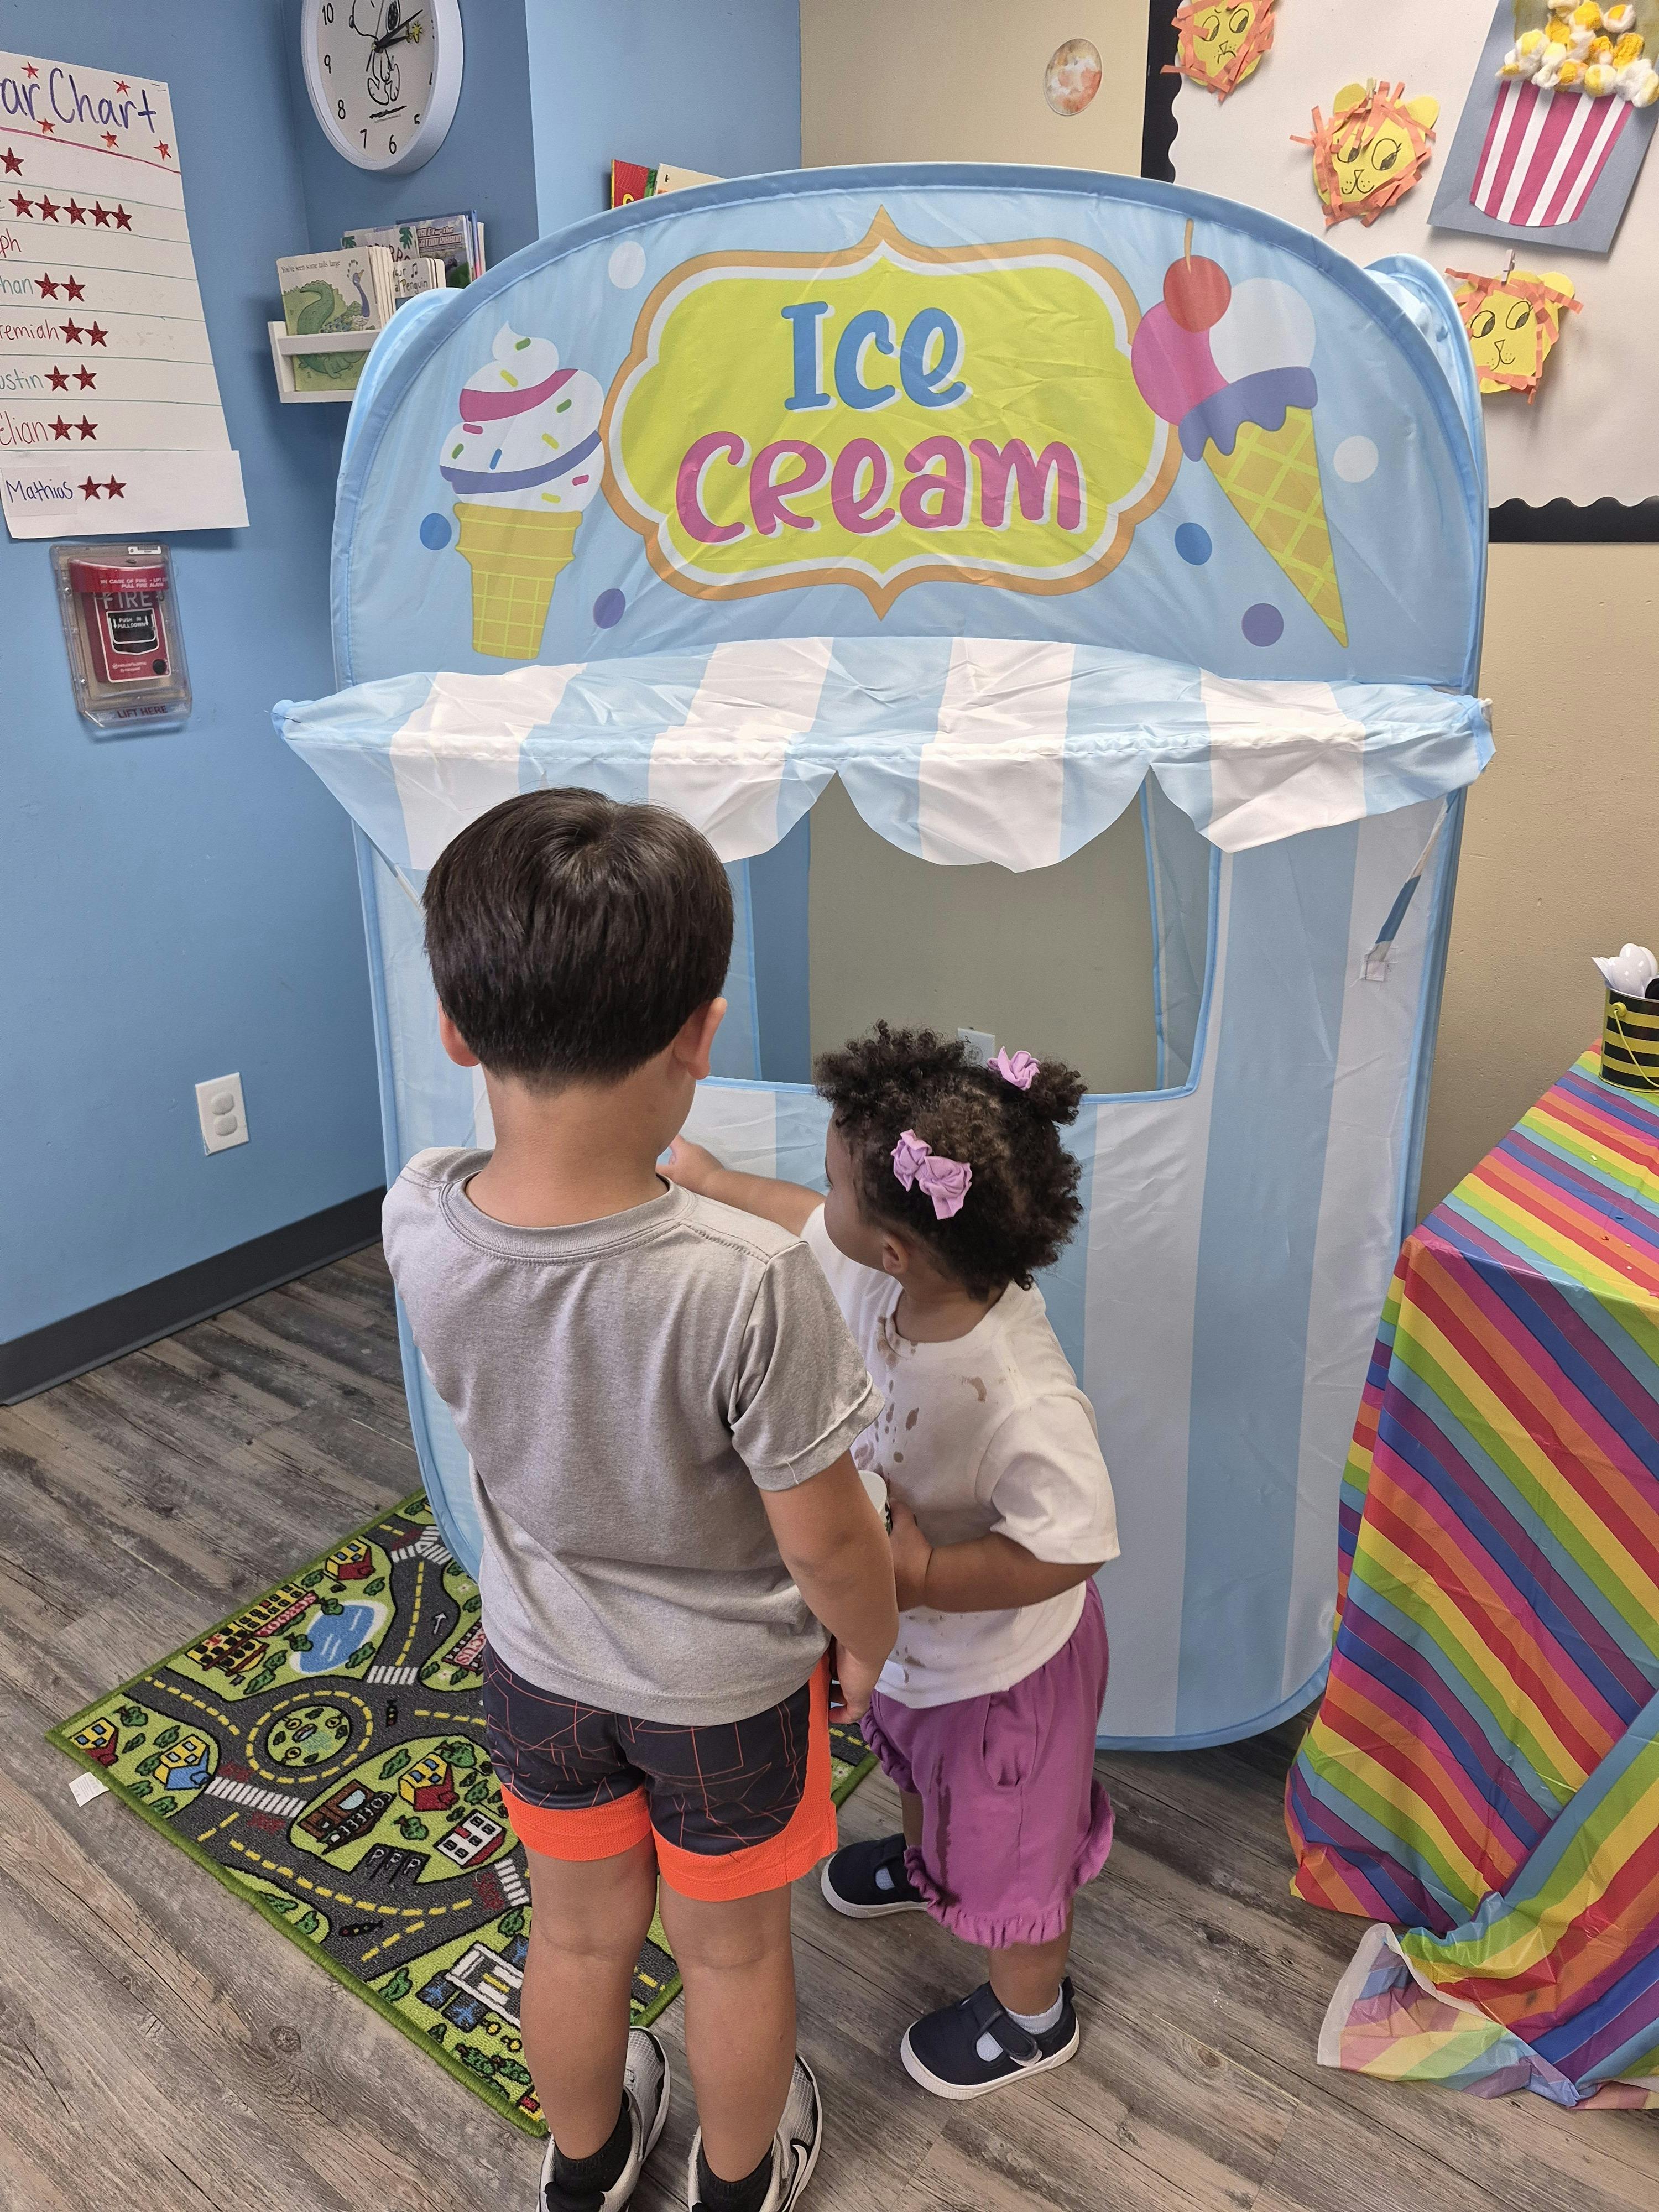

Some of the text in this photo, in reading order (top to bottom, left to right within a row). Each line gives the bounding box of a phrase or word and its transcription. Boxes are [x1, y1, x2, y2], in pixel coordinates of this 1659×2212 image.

[322, 3, 334, 25] 10
[324, 54, 331, 74] 9
[0, 67, 156, 133] ar Chart
[338, 99, 346, 120] 8
[360, 128, 367, 149] 7
[389, 134, 397, 154] 6
[0, 228, 22, 258] ph
[0, 276, 33, 295] han
[400, 277, 429, 294] Penguin
[781, 301, 971, 411] Ice
[5, 478, 73, 503] Mathias
[103, 592, 153, 609] FIRE
[117, 705, 168, 718] LIFT HERE
